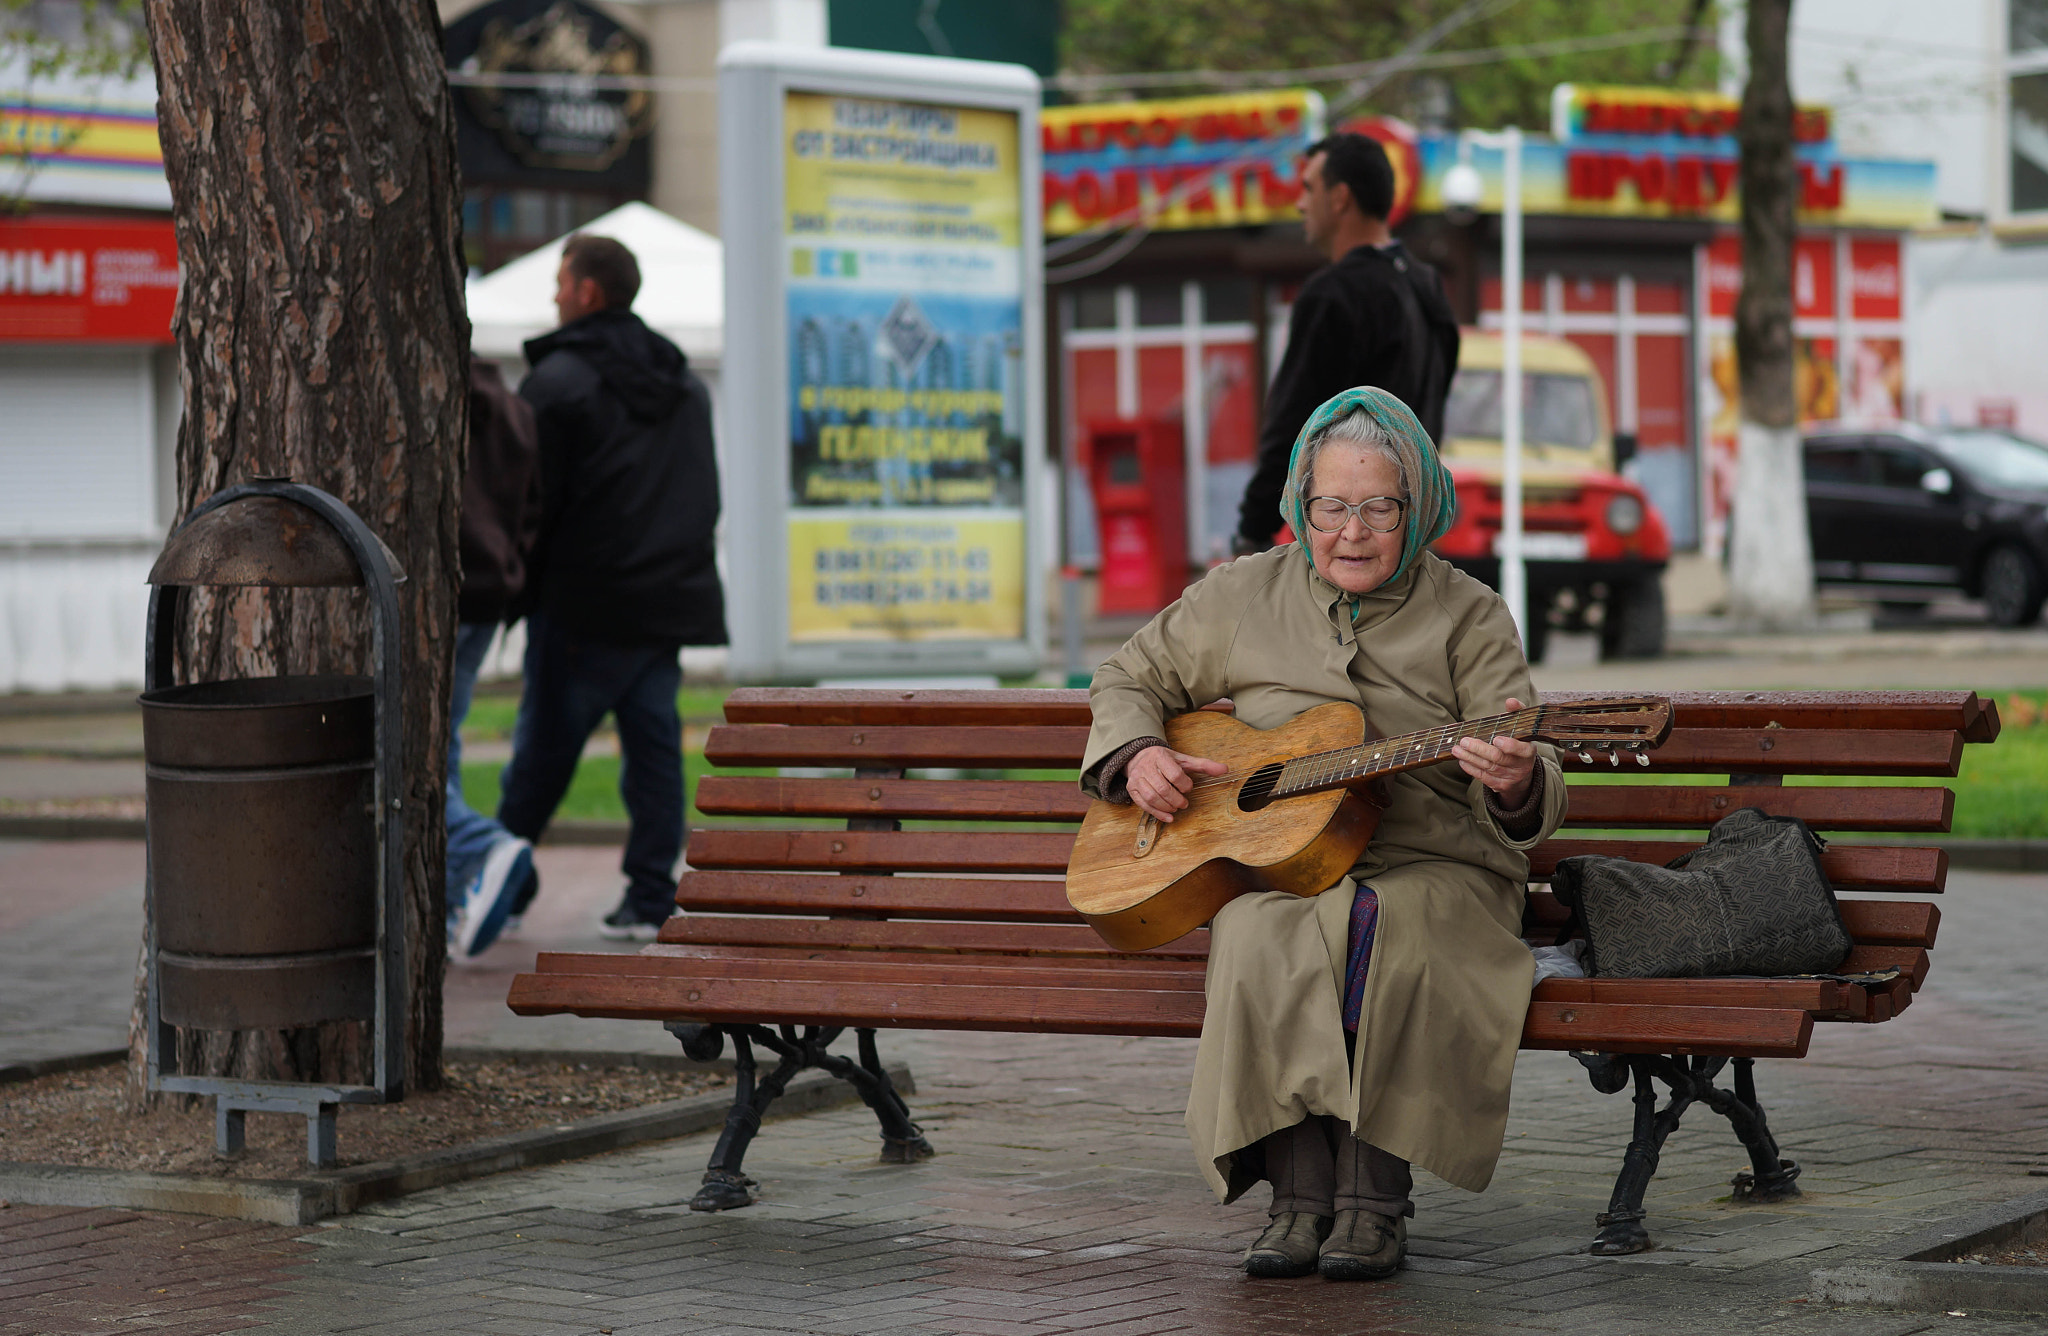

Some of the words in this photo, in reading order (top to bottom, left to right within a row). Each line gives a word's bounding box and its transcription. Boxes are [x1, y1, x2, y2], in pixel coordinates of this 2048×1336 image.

[834, 103, 957, 135] КВАРТИРЫ
[794, 130, 825, 157] ОТ
[831, 133, 998, 171] ЗАСТРОЙЩИКА
[1042, 155, 1306, 222] РОДУКТЫ
[1568, 152, 1843, 212] ПРОДУЫ
[821, 427, 988, 464] ГЕЛЕНДЖИК
